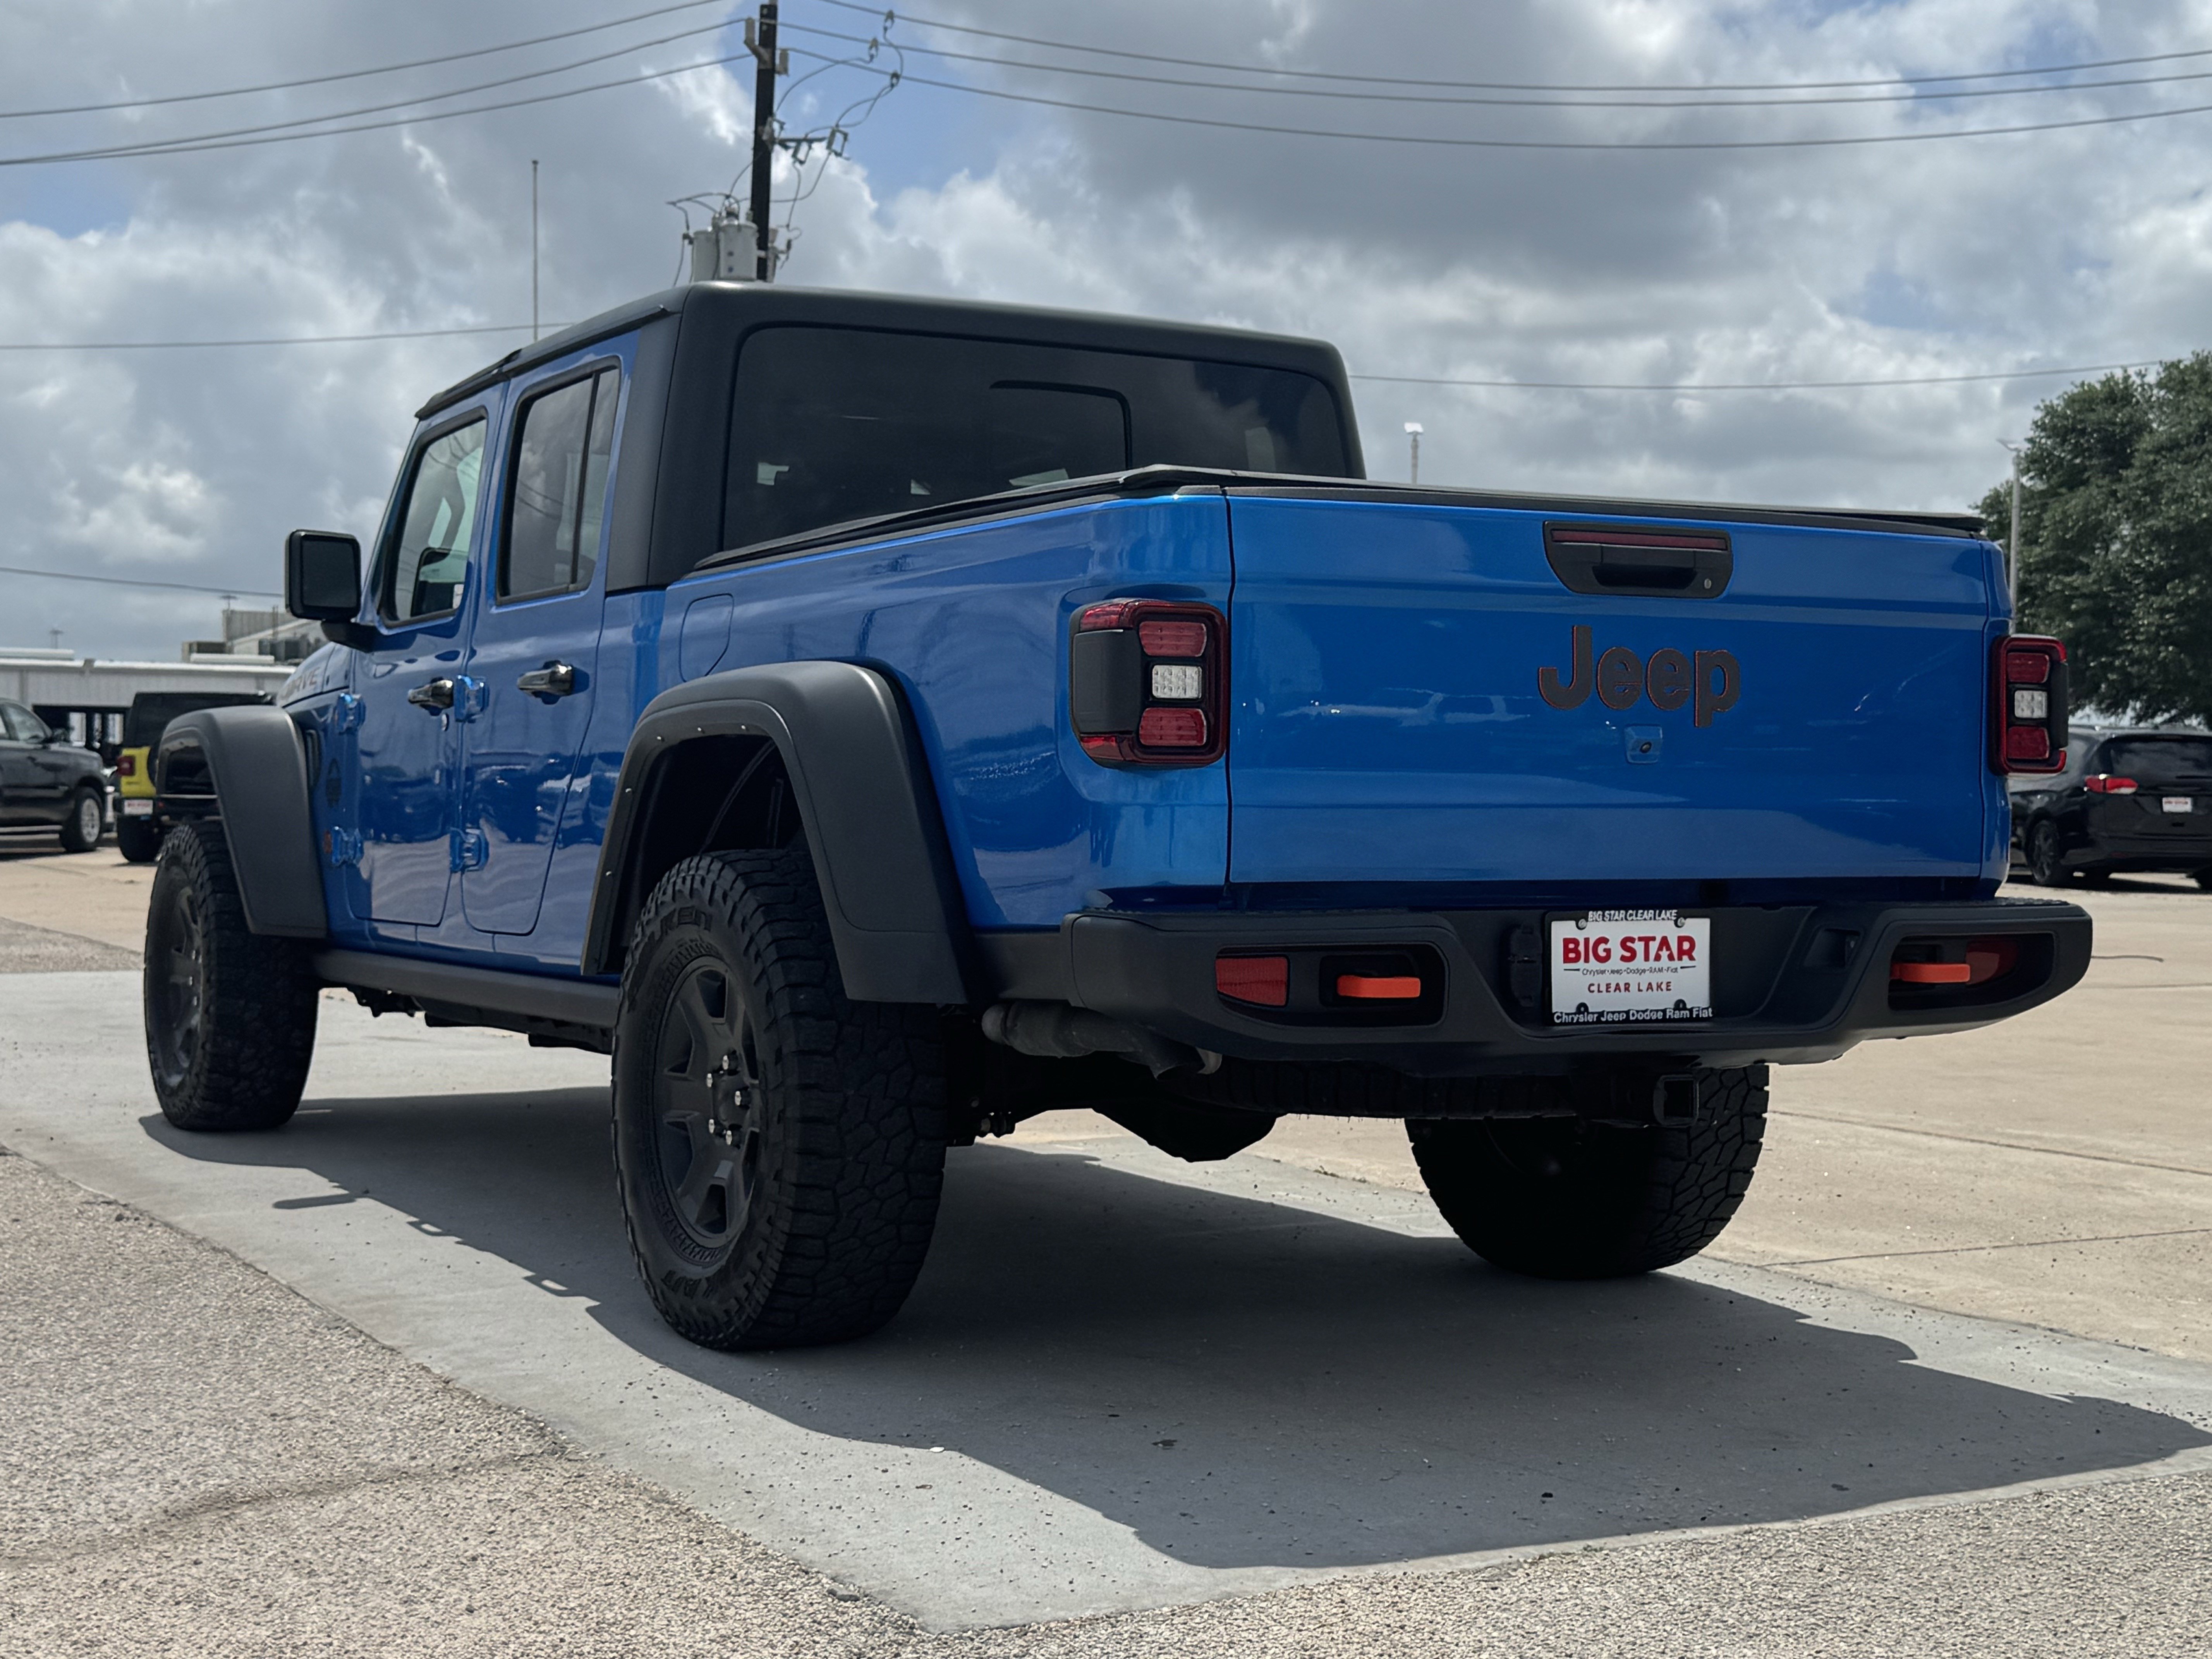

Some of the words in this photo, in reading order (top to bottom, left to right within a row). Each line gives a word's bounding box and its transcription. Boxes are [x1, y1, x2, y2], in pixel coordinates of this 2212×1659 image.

[1538, 625, 1740, 727] Jeep
[1588, 910, 1602, 921] BIG
[1604, 910, 1626, 921] STAR
[1627, 910, 1654, 920] CLEAR
[1656, 909, 1678, 920] LAKE
[1563, 936, 1611, 964] BIG
[1620, 935, 1696, 962] STAR
[1587, 982, 1631, 993] CLEAR
[1637, 981, 1672, 992] LAKE
[1554, 1012, 1597, 1023] Chrysler
[1601, 1011, 1626, 1022] Jeep
[1629, 1010, 1663, 1020] Dodge
[1666, 1009, 1690, 1018] Ram
[1693, 1007, 1712, 1018] Fiat
